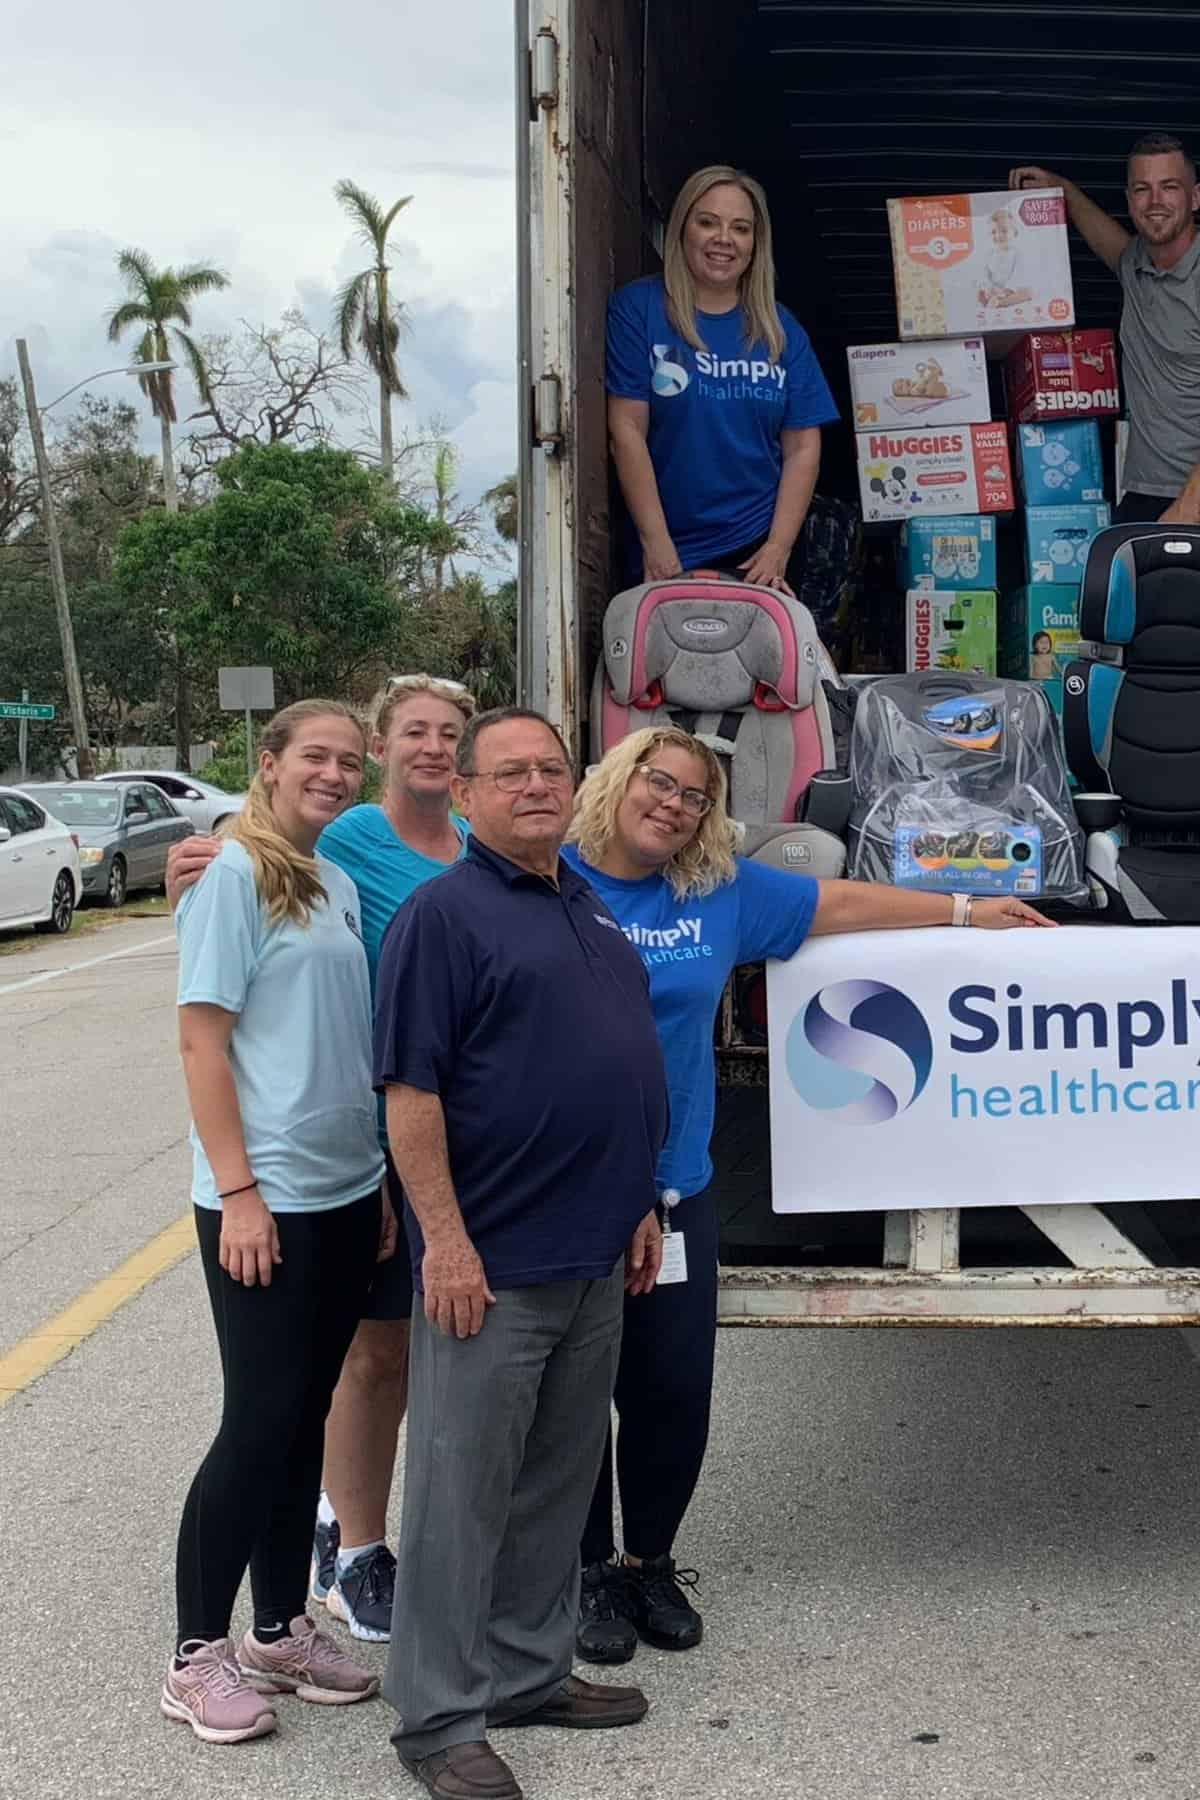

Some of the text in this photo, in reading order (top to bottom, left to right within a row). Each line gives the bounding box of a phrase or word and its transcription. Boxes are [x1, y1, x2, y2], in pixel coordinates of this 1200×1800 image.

[933, 241, 945, 255] 3
[851, 348, 897, 361] diapers
[695, 351, 787, 389] Simply
[1035, 389, 1120, 411] HUGGIES
[869, 435, 963, 459] HUGGIES
[915, 600, 931, 672] HUGGIES
